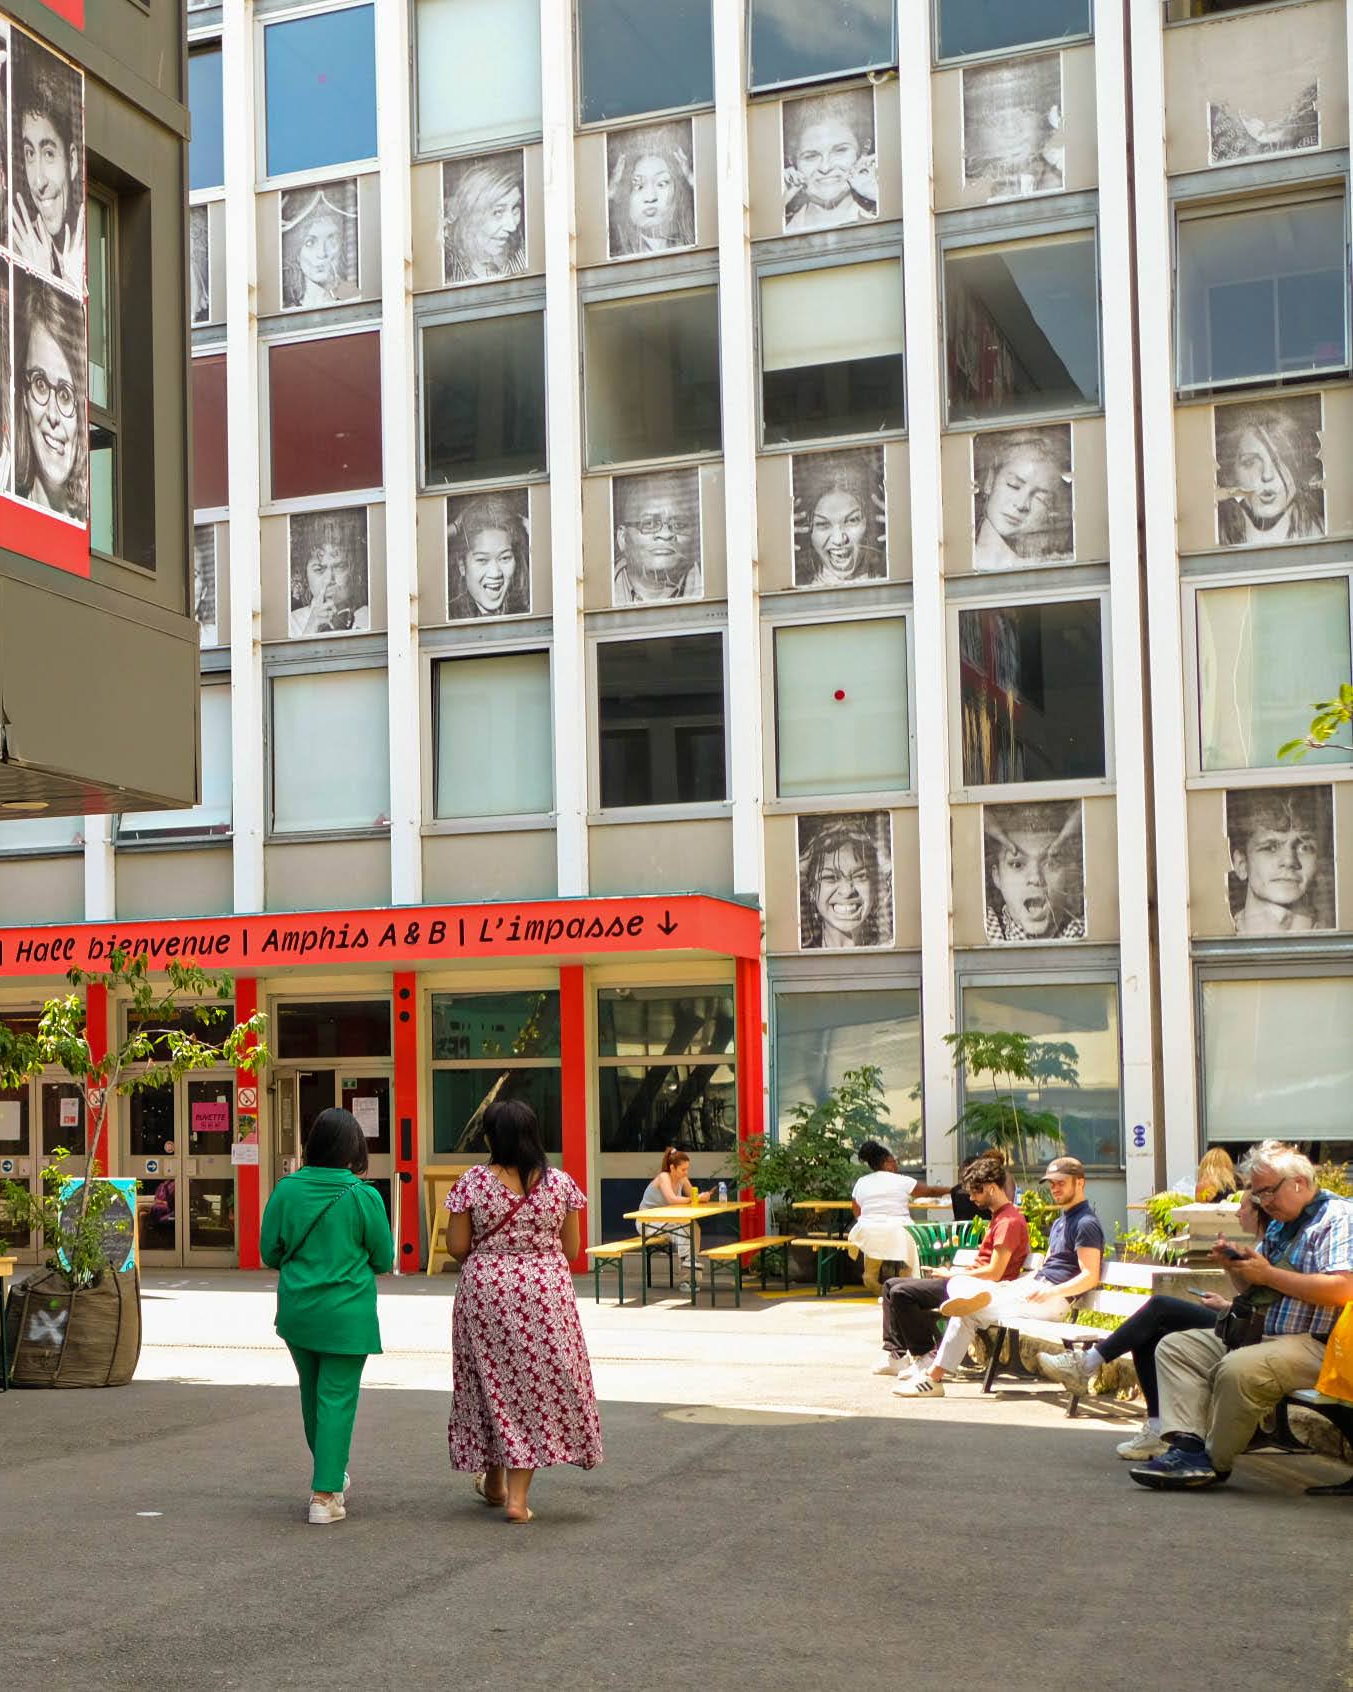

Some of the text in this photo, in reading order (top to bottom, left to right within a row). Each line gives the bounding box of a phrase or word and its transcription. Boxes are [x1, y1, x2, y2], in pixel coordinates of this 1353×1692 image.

[15, 937, 76, 963] Hall
[87, 934, 232, 961] bienvenue
[261, 923, 369, 956] Amphis
[478, 914, 645, 945] L'impasse
